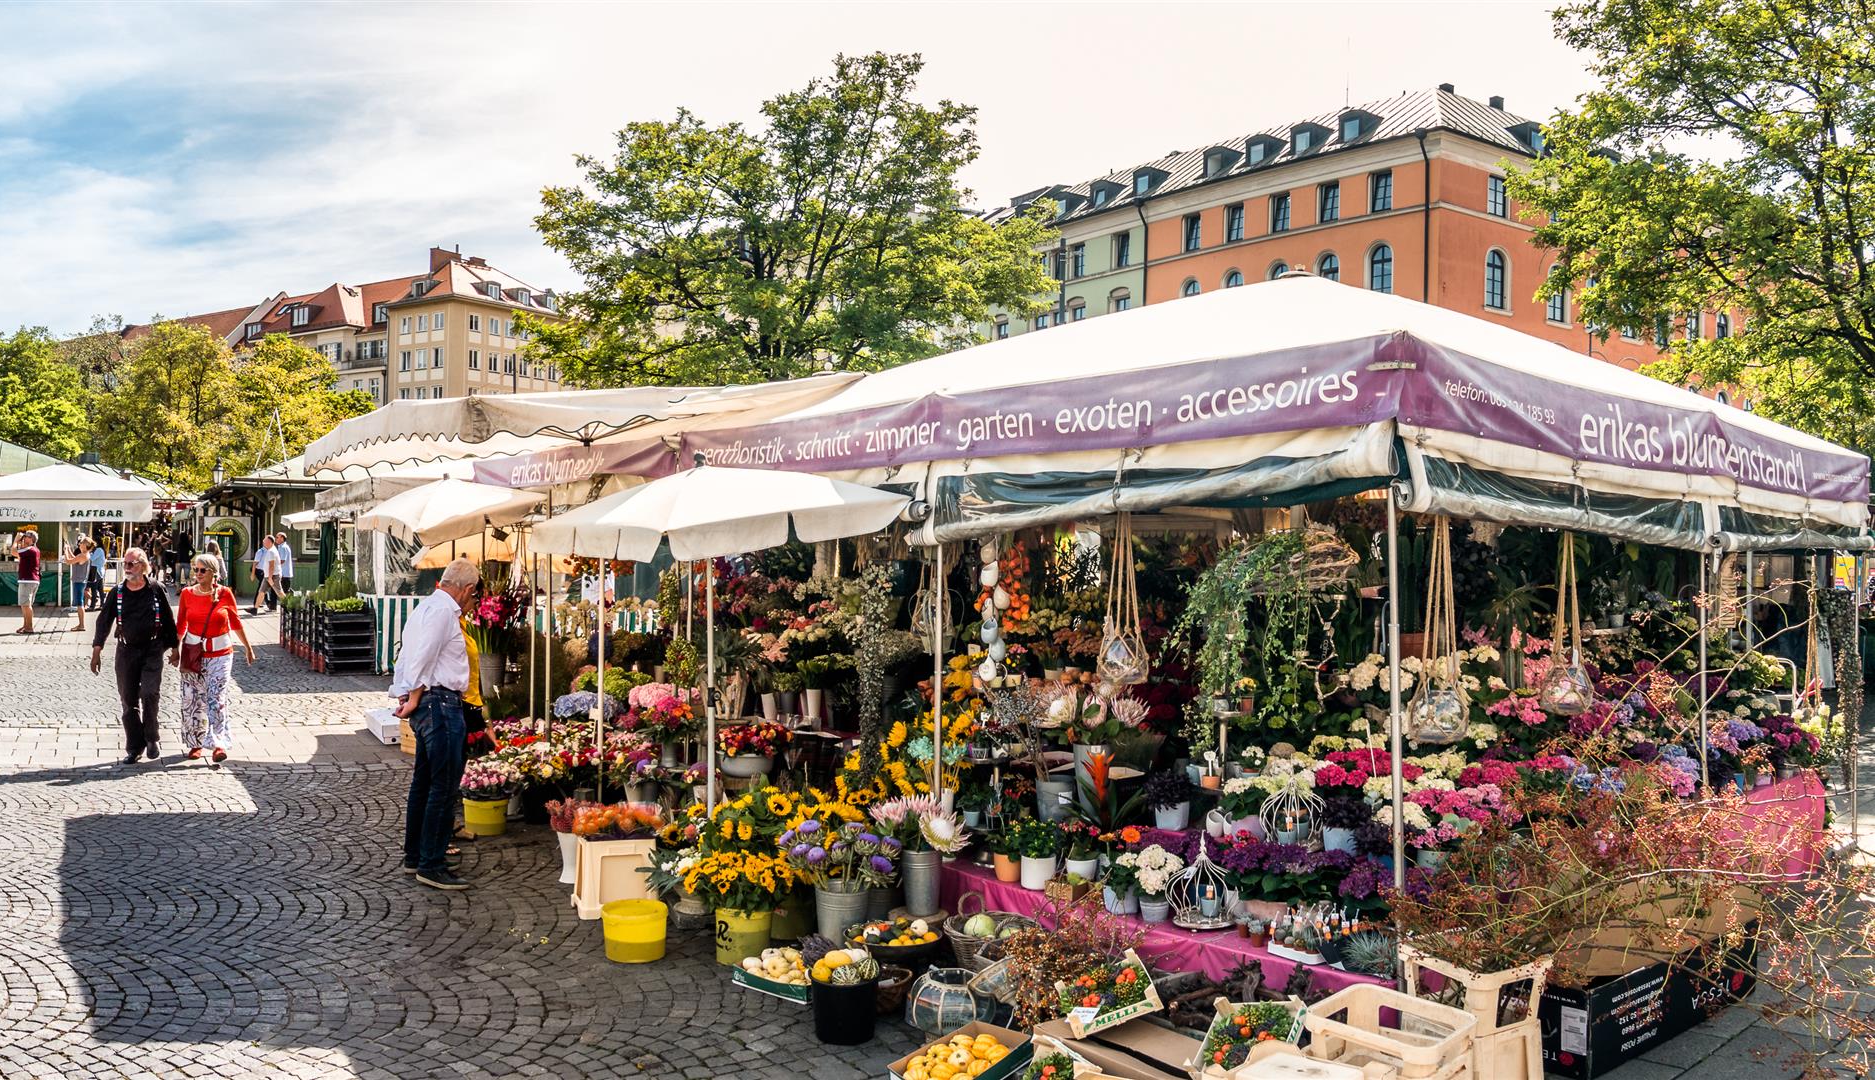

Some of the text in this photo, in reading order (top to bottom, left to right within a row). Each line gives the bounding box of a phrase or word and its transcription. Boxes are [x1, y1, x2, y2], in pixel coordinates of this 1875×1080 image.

[795, 431, 852, 462] schnitt
[865, 420, 941, 453] zimmer
[956, 407, 1034, 451] garten
[1054, 396, 1152, 435] exoten
[1176, 366, 1358, 423] accessoires
[1445, 379, 1488, 404] telefon:
[1527, 404, 1543, 422] 185
[1544, 408, 1556, 425] 93
[1579, 403, 1664, 464] erikas
[511, 458, 542, 485] erikas
[69, 509, 124, 518] SAFTBAR
[1095, 1006, 1139, 1027] MELLI
